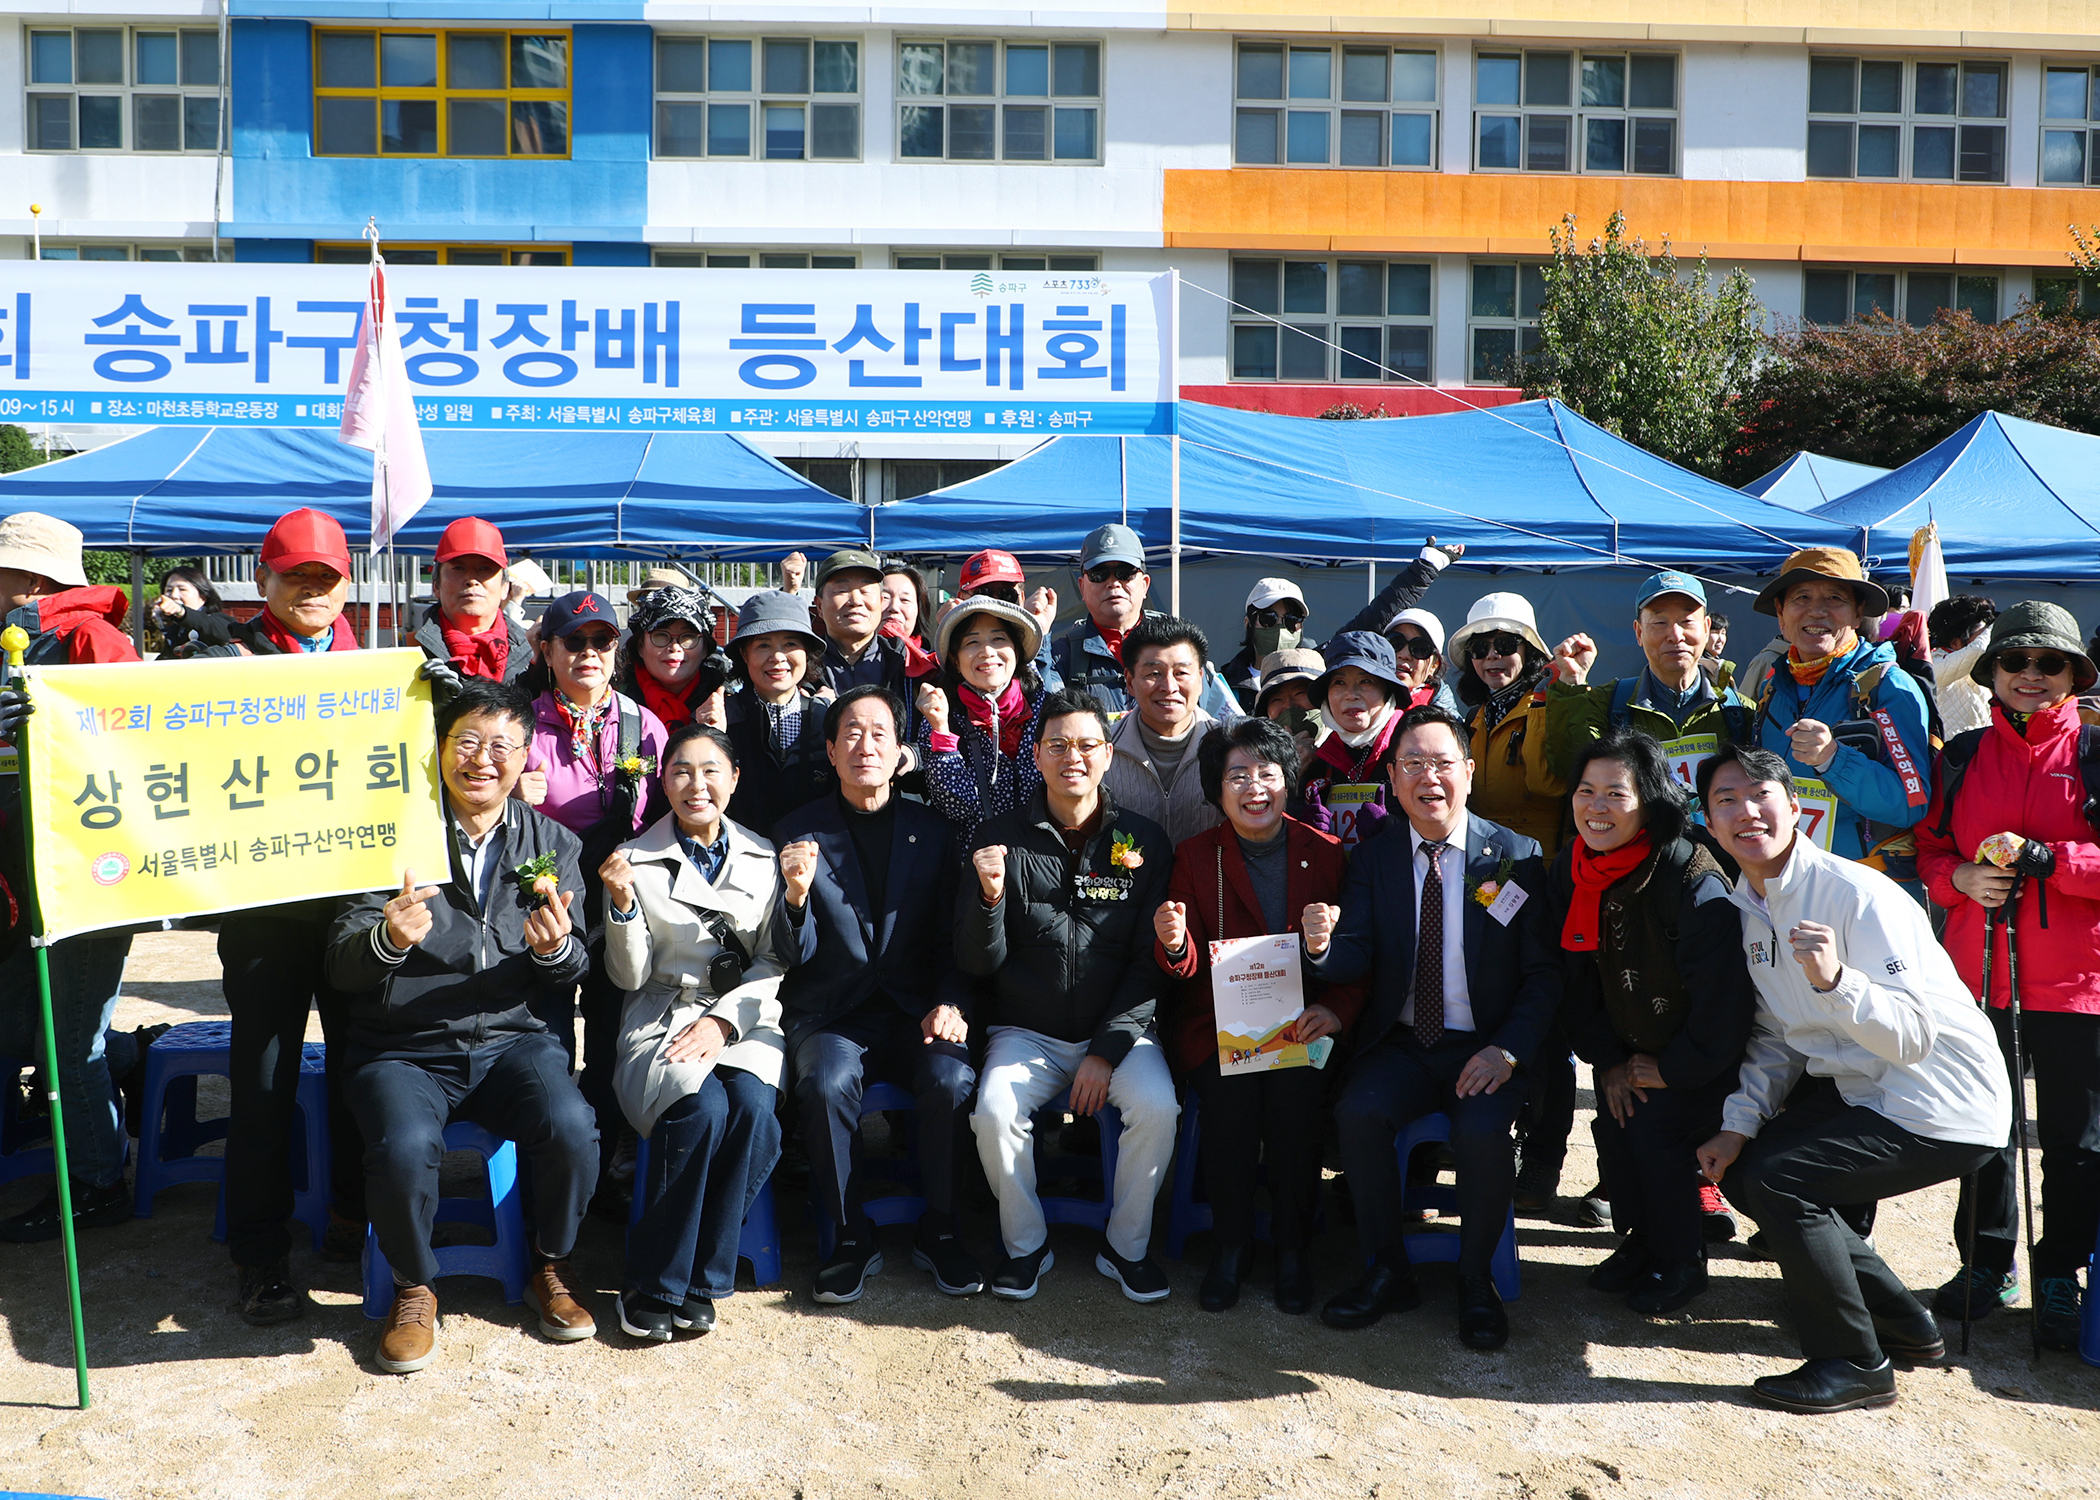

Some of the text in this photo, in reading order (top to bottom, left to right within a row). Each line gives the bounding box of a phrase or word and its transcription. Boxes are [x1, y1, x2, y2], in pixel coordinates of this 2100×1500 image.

[998, 283, 1027, 293] 송파구
[1043, 280, 1068, 289] 스포츠
[84, 294, 680, 389] 송파구청장배
[729, 301, 1127, 392] 등산대회
[107, 400, 143, 417] 장소:
[146, 401, 280, 420] 마천초등학교운동장
[443, 404, 473, 422] 일원
[505, 405, 542, 422] 주최:
[546, 406, 621, 424] 서울특별시
[627, 407, 716, 425] 송파구체육회
[743, 409, 779, 426] 주관:
[784, 409, 859, 427] 서울특별시
[1000, 410, 1043, 428] 후원:
[1048, 411, 1094, 429] 송파구
[75, 686, 401, 736] 제12회 송파구청장배 등산대회
[137, 840, 238, 878] 서울특별시
[249, 822, 397, 863] 송파구산악연맹
